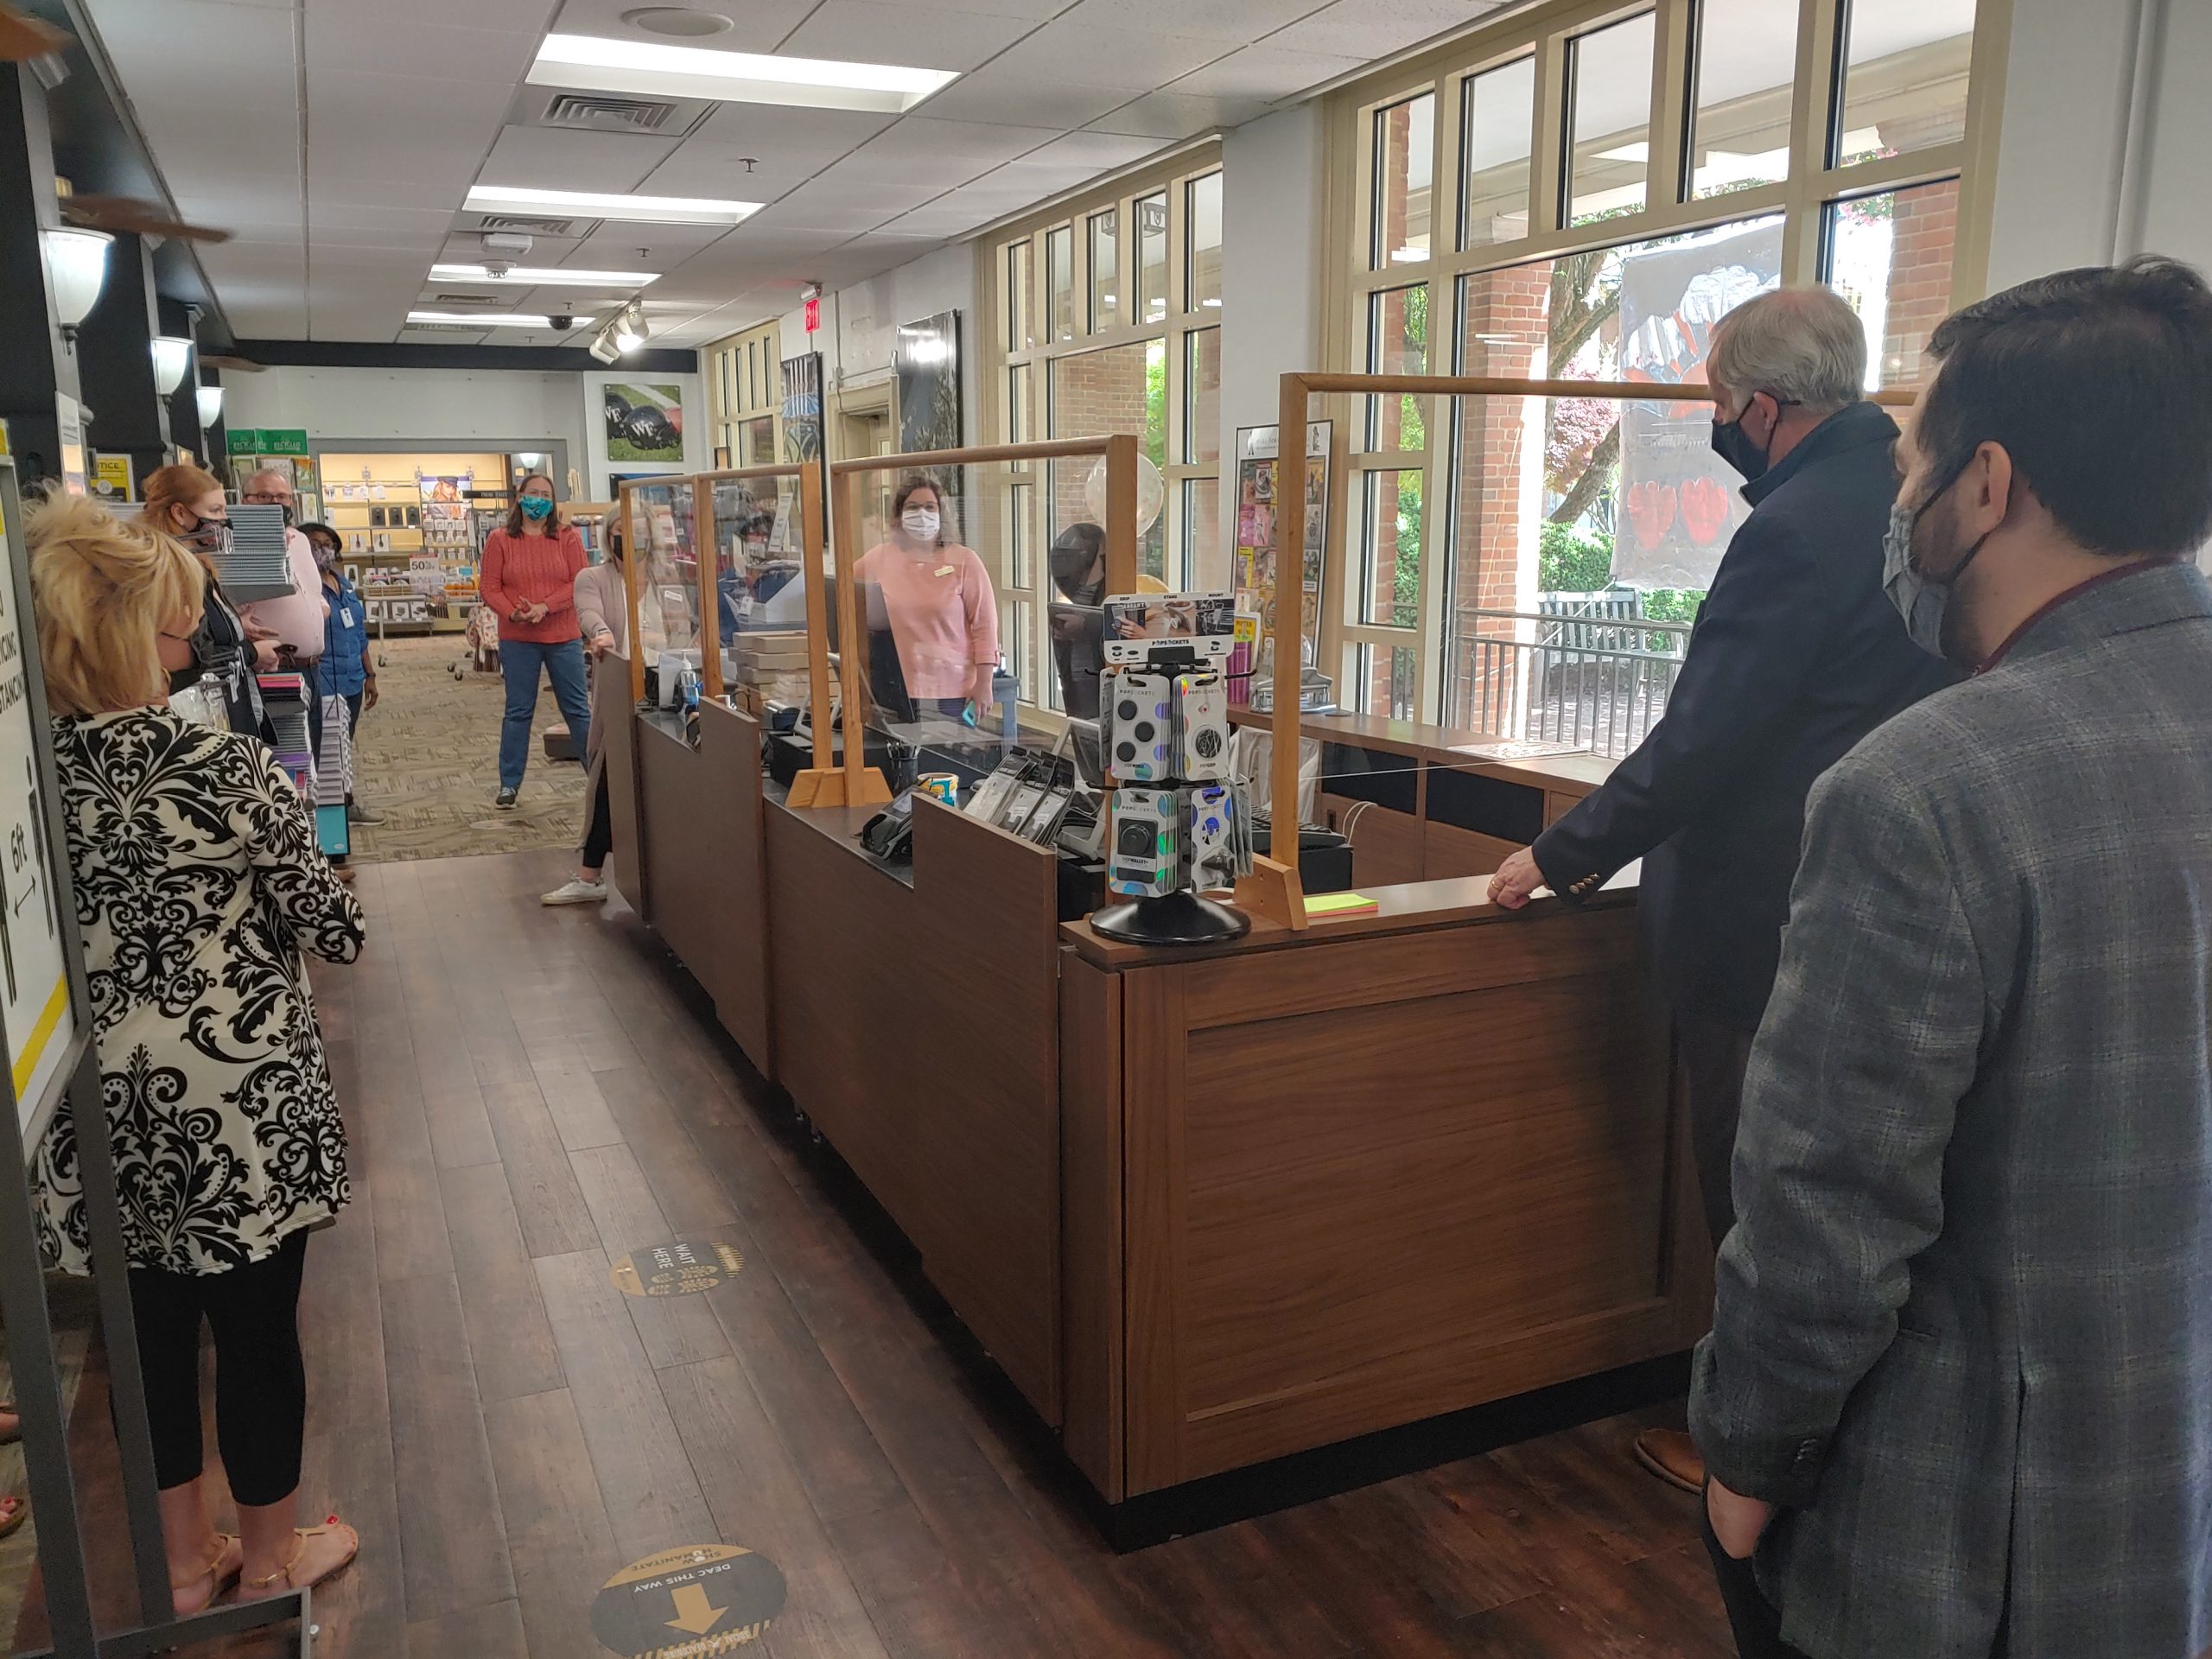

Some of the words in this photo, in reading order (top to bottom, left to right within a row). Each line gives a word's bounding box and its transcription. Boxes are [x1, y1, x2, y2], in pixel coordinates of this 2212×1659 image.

[631, 420, 654, 437] WF
[11, 822, 27, 874] 6ft
[652, 1247, 675, 1269] HERE
[674, 1243, 696, 1264] WAIT
[665, 1572, 696, 1585] THIS
[697, 1563, 732, 1577] DEAC
[632, 1580, 663, 1593] WAY
